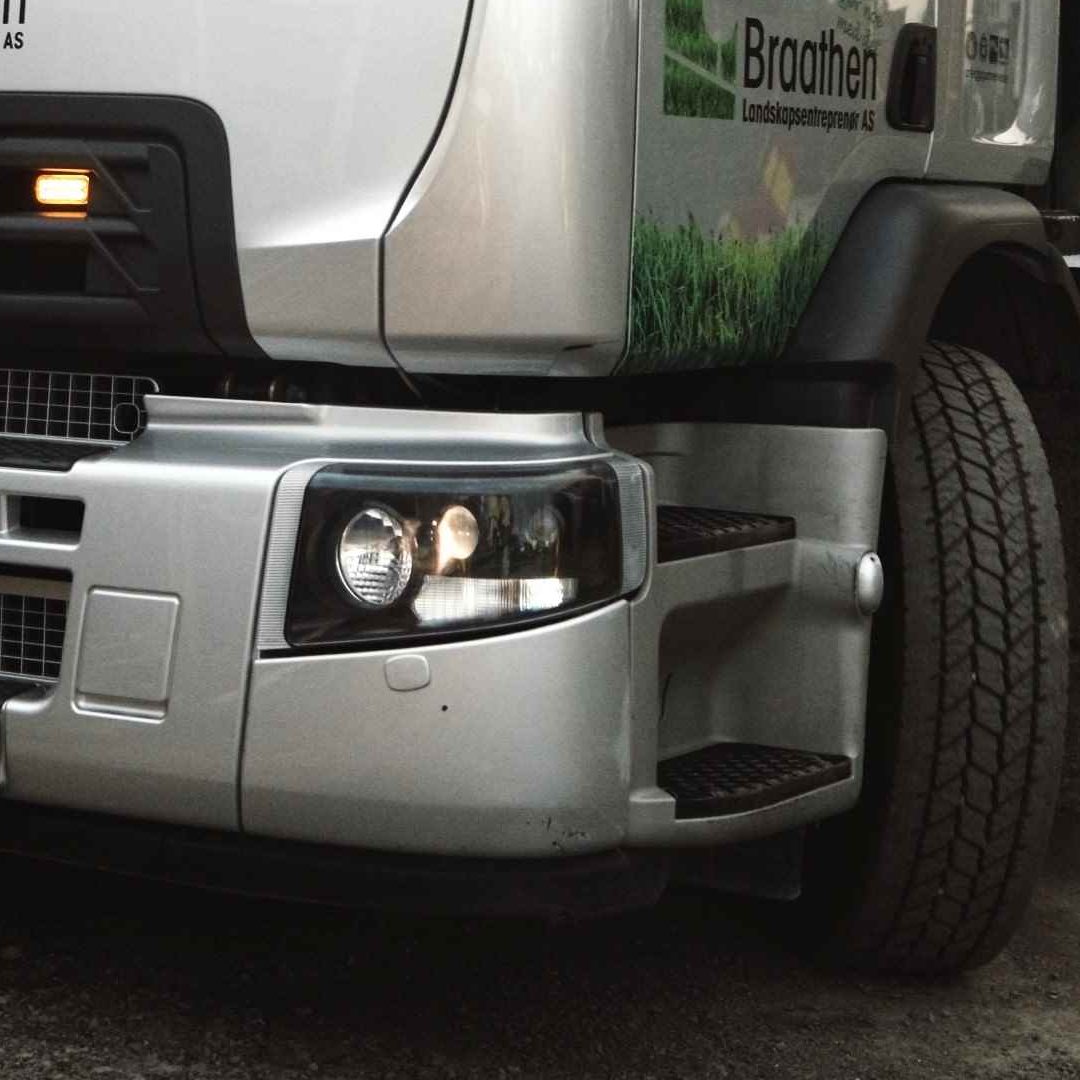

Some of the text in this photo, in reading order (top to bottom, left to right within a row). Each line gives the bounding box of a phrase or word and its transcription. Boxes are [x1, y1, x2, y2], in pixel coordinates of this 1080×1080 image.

[3, 32, 24, 50] AS
[743, 16, 877, 100] Braathen
[861, 109, 876, 132] AS
